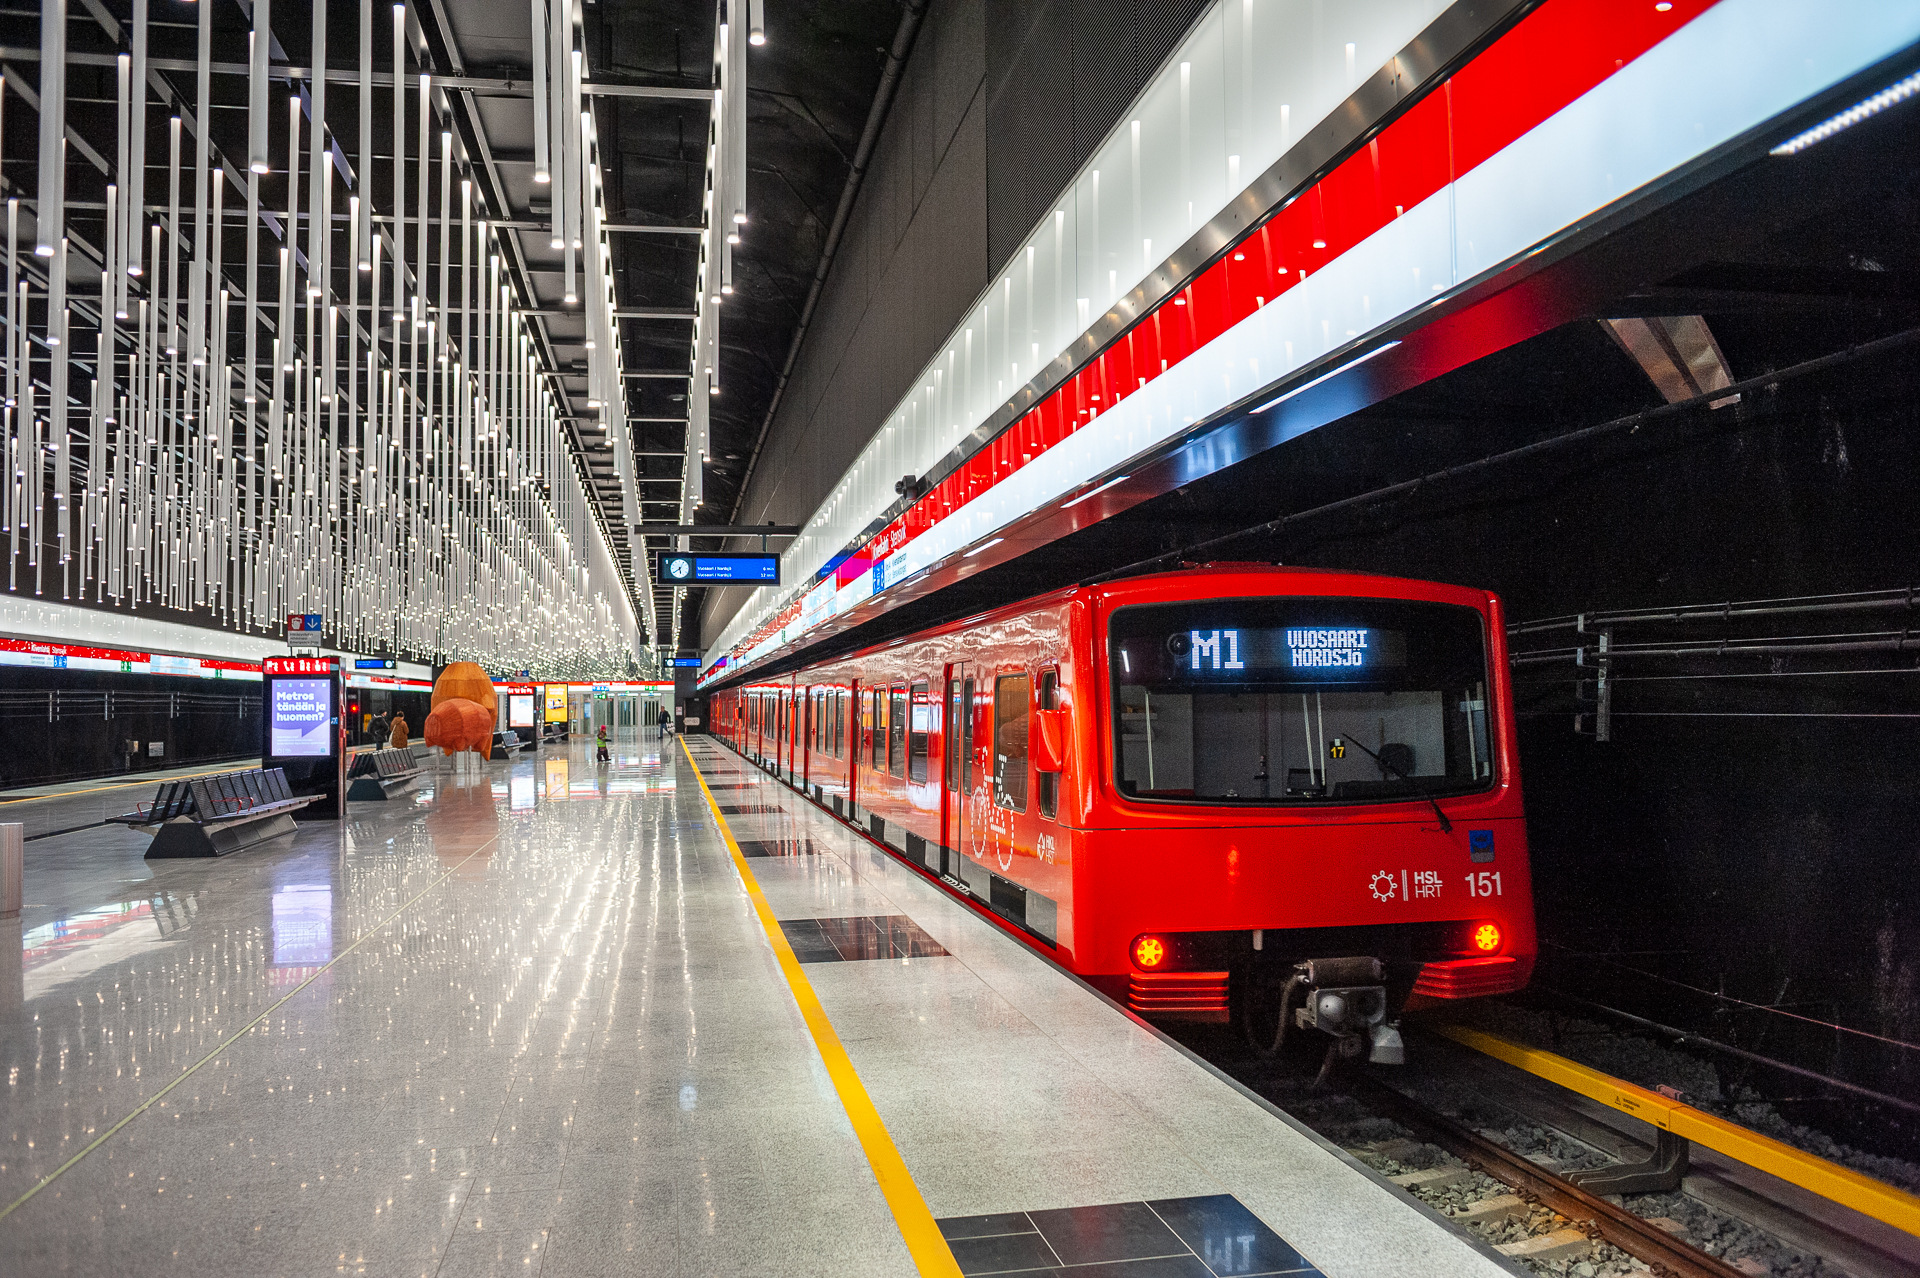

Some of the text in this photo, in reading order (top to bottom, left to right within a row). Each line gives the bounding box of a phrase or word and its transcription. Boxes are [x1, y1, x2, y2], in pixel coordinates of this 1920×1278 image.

[891, 521, 906, 547] Stensvik
[1287, 630, 1368, 648] VUOSAARI
[1191, 630, 1244, 669] M1
[1292, 648, 1362, 667] NORDSJÖ
[276, 692, 314, 701] Metros
[276, 702, 326, 713] tänään ja
[276, 712, 325, 722] huomen?
[1330, 746, 1345, 758] 17
[1413, 871, 1443, 885] HSL
[1464, 871, 1502, 898] 151
[1415, 884, 1443, 898] HRT
